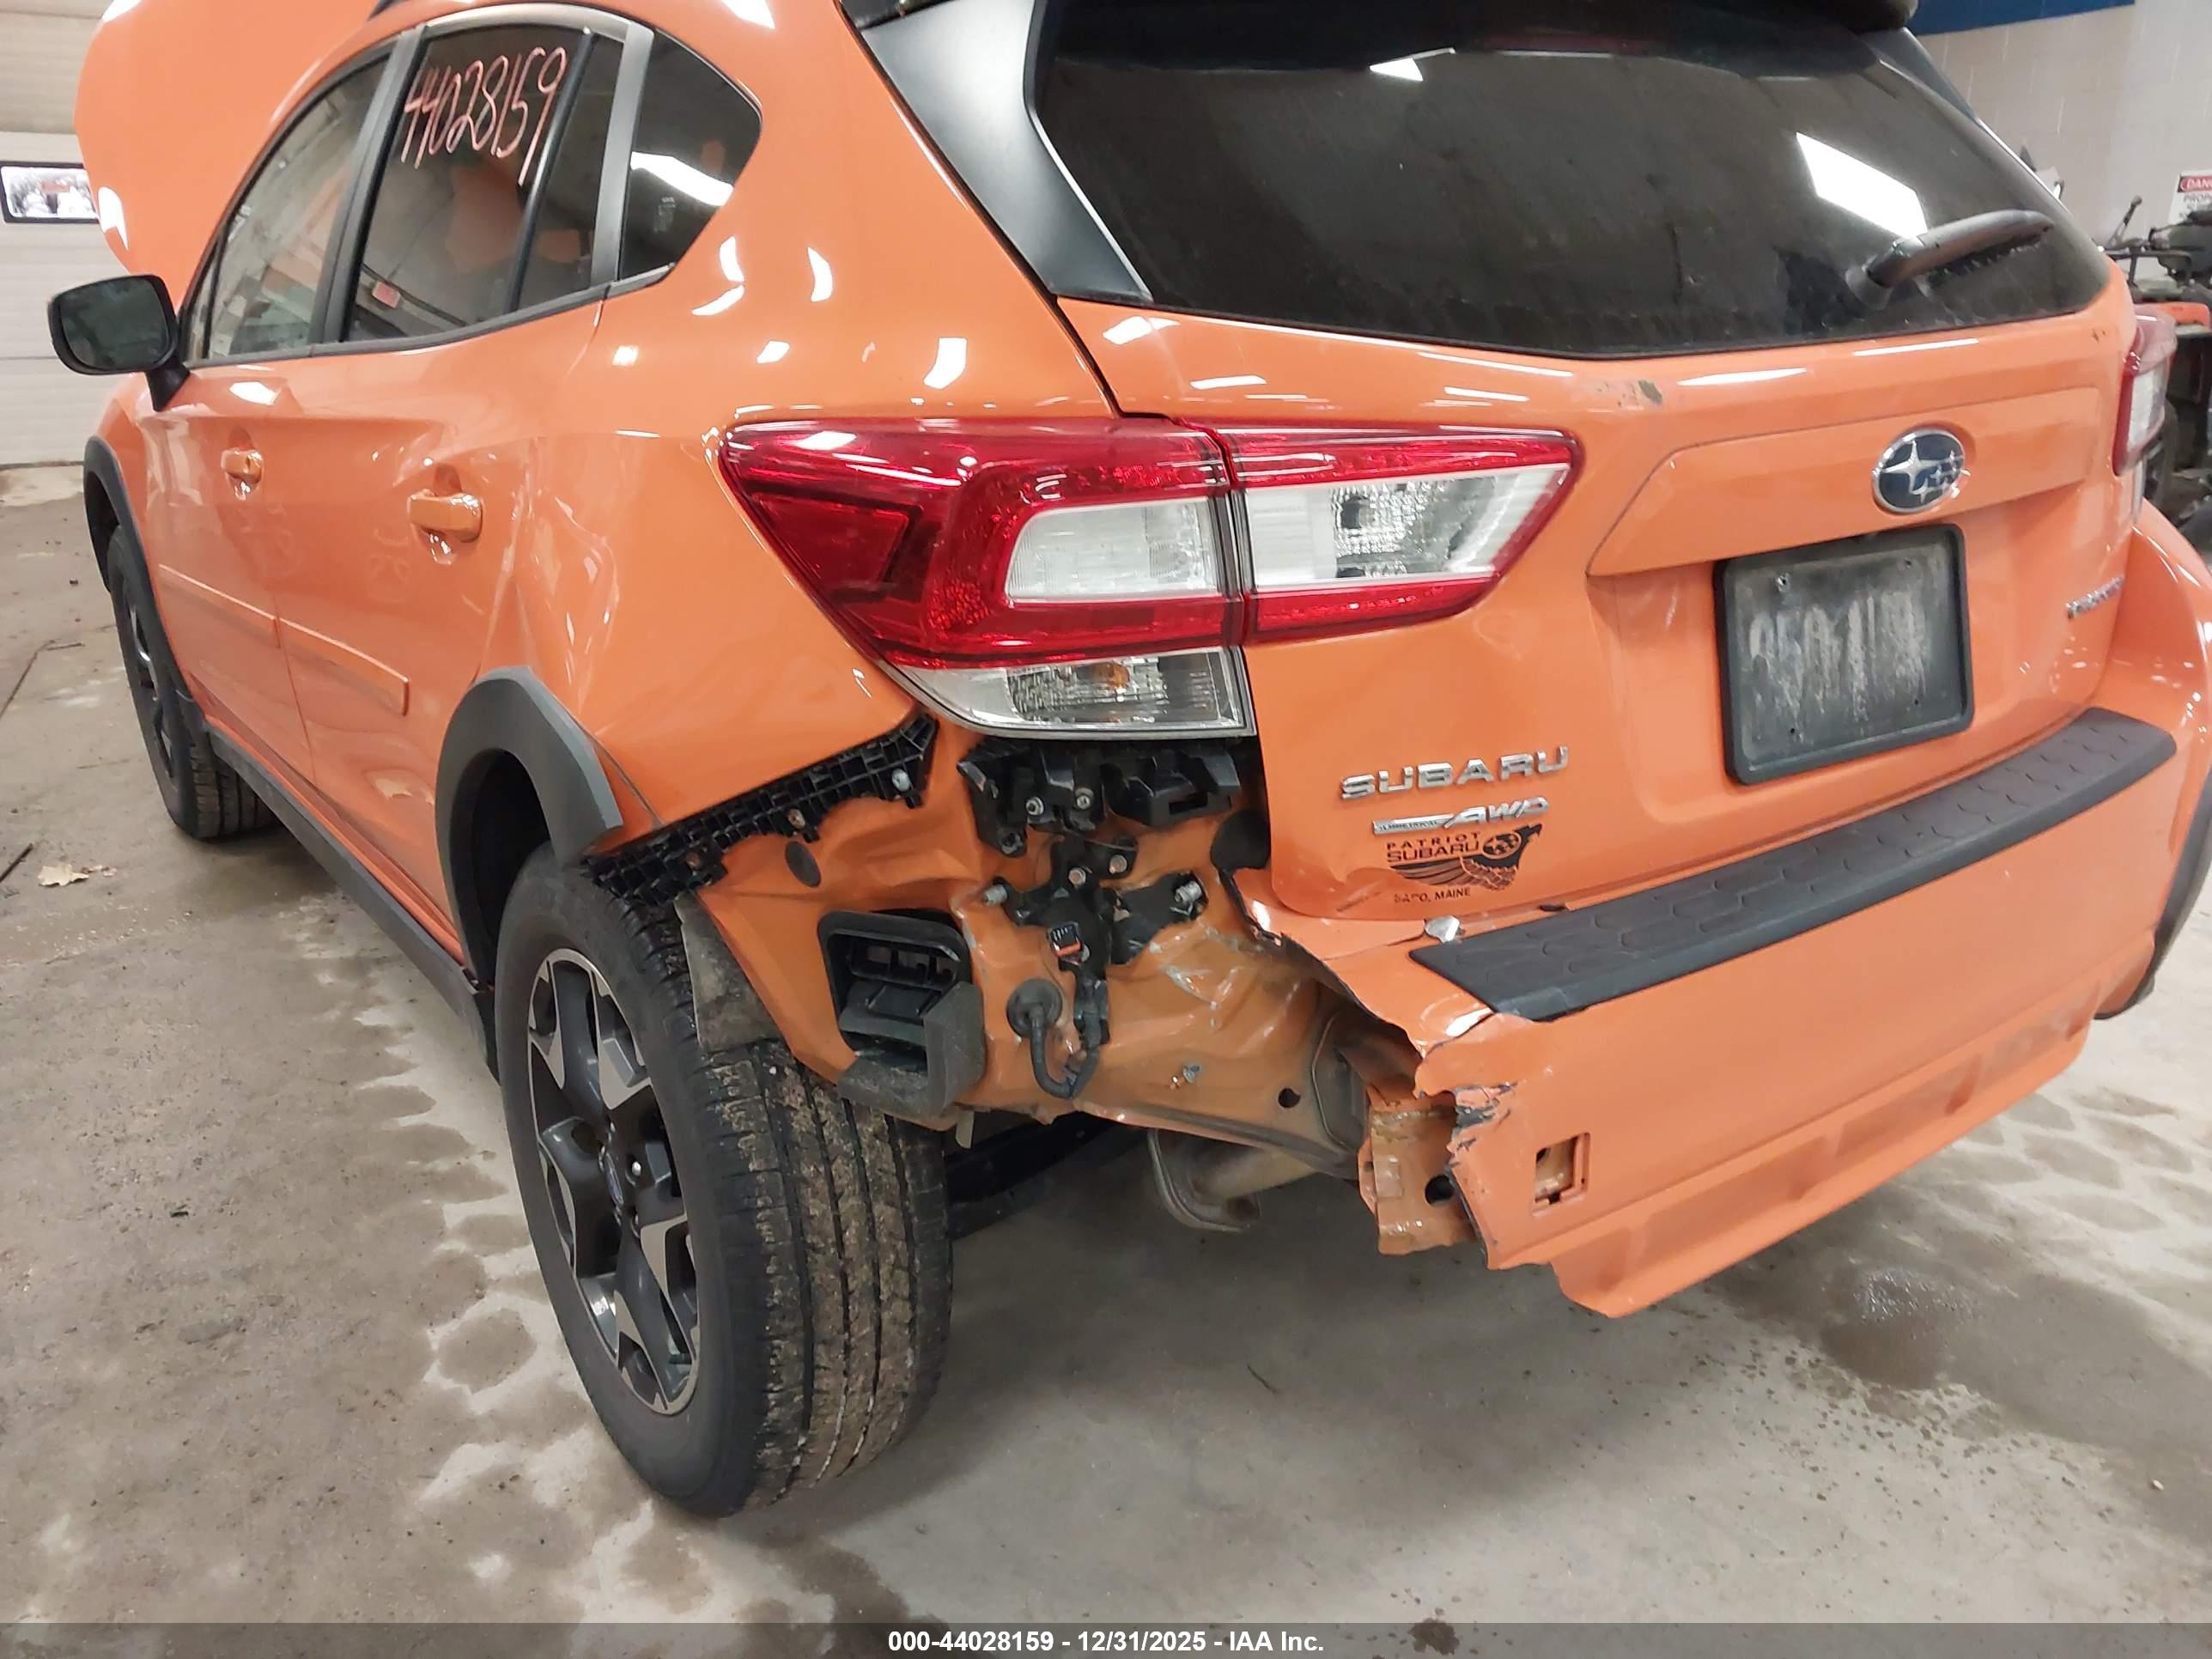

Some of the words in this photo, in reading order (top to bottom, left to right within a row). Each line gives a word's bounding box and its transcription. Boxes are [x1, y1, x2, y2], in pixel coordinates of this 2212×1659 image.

[400, 46, 567, 186] 44028159
[1341, 745, 1568, 800] SUBARU
[1443, 797, 1549, 830] AWD
[1387, 831, 1480, 850] PATRIOT
[1387, 841, 1479, 862] SUBARU
[1435, 887, 1471, 900] MAINE
